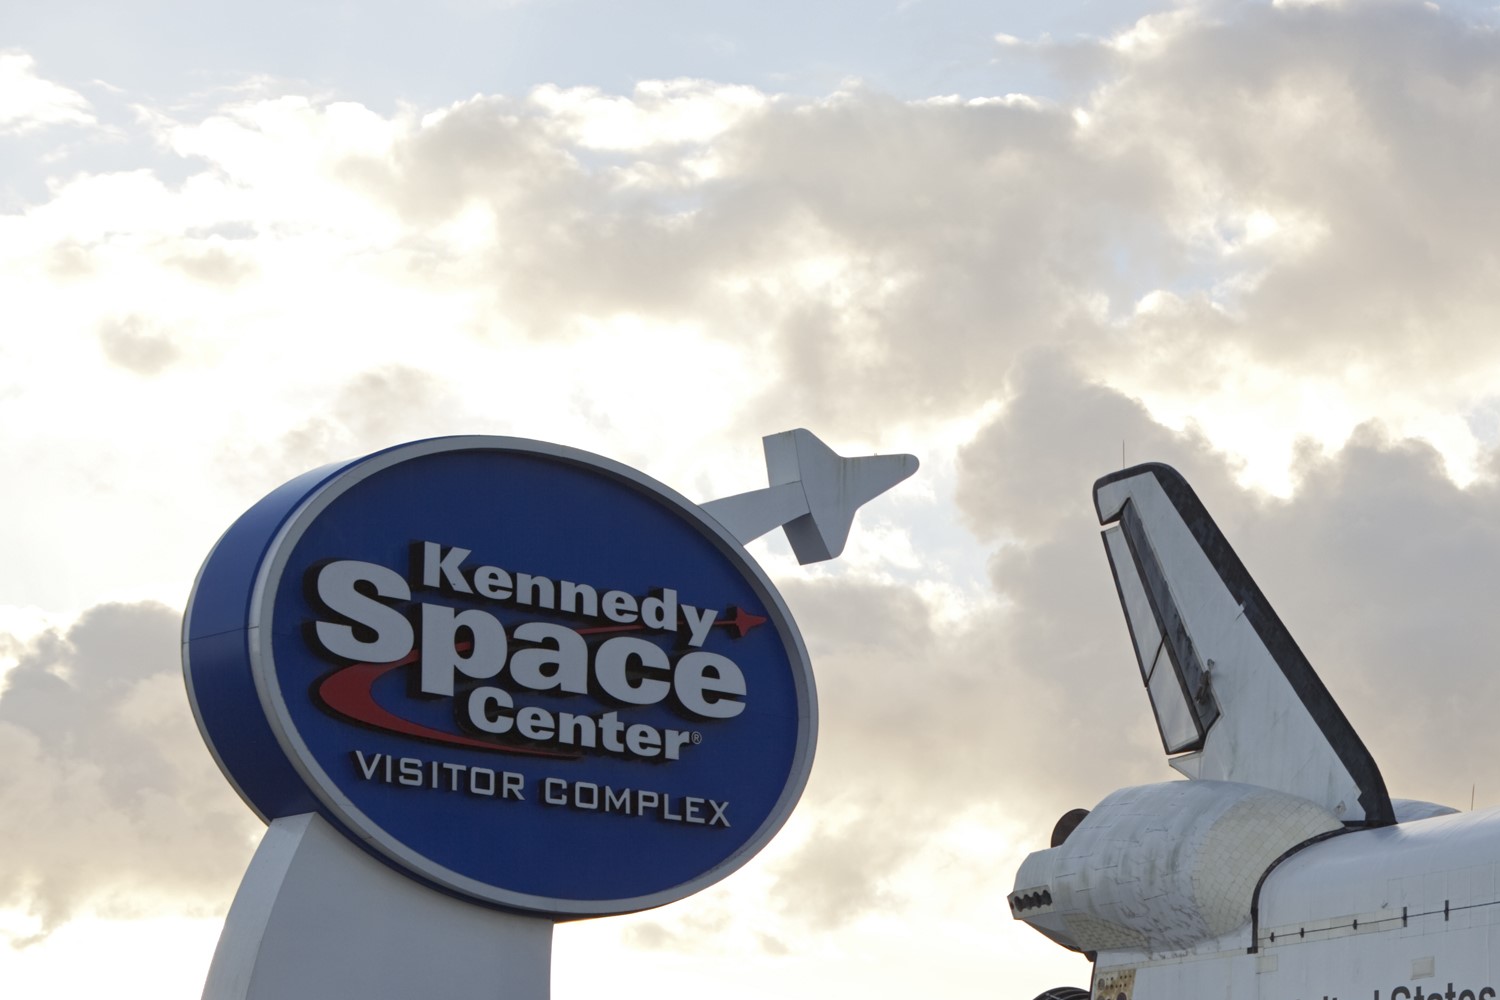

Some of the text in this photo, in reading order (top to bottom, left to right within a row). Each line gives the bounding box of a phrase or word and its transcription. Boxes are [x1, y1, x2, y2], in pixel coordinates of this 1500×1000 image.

[315, 559, 747, 719] Space
[422, 540, 719, 648] Kennedy
[355, 750, 732, 827] VISITOR COMPLEX
